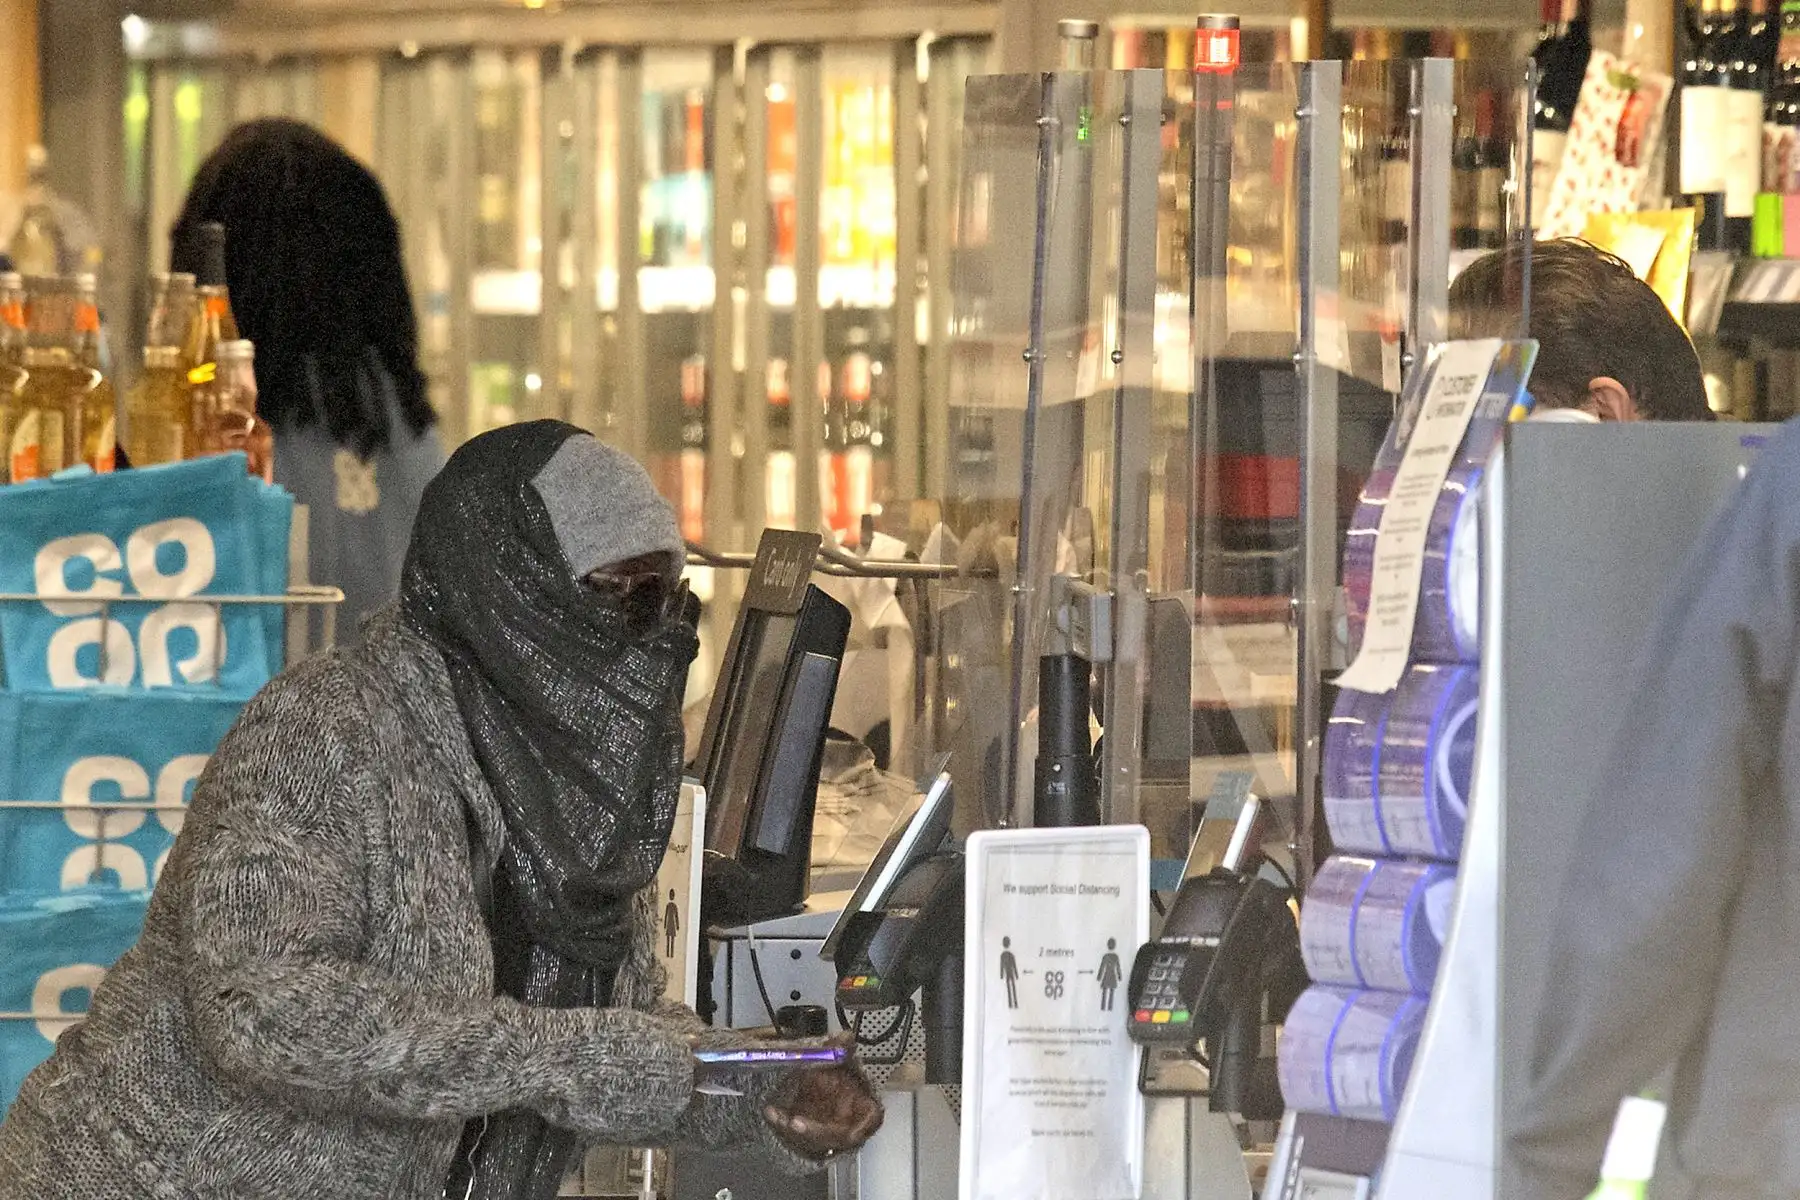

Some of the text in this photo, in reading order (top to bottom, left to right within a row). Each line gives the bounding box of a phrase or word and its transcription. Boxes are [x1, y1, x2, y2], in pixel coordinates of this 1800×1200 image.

[1003, 884, 1119, 897] We support Social Distancing
[1046, 947, 1074, 957] metres
